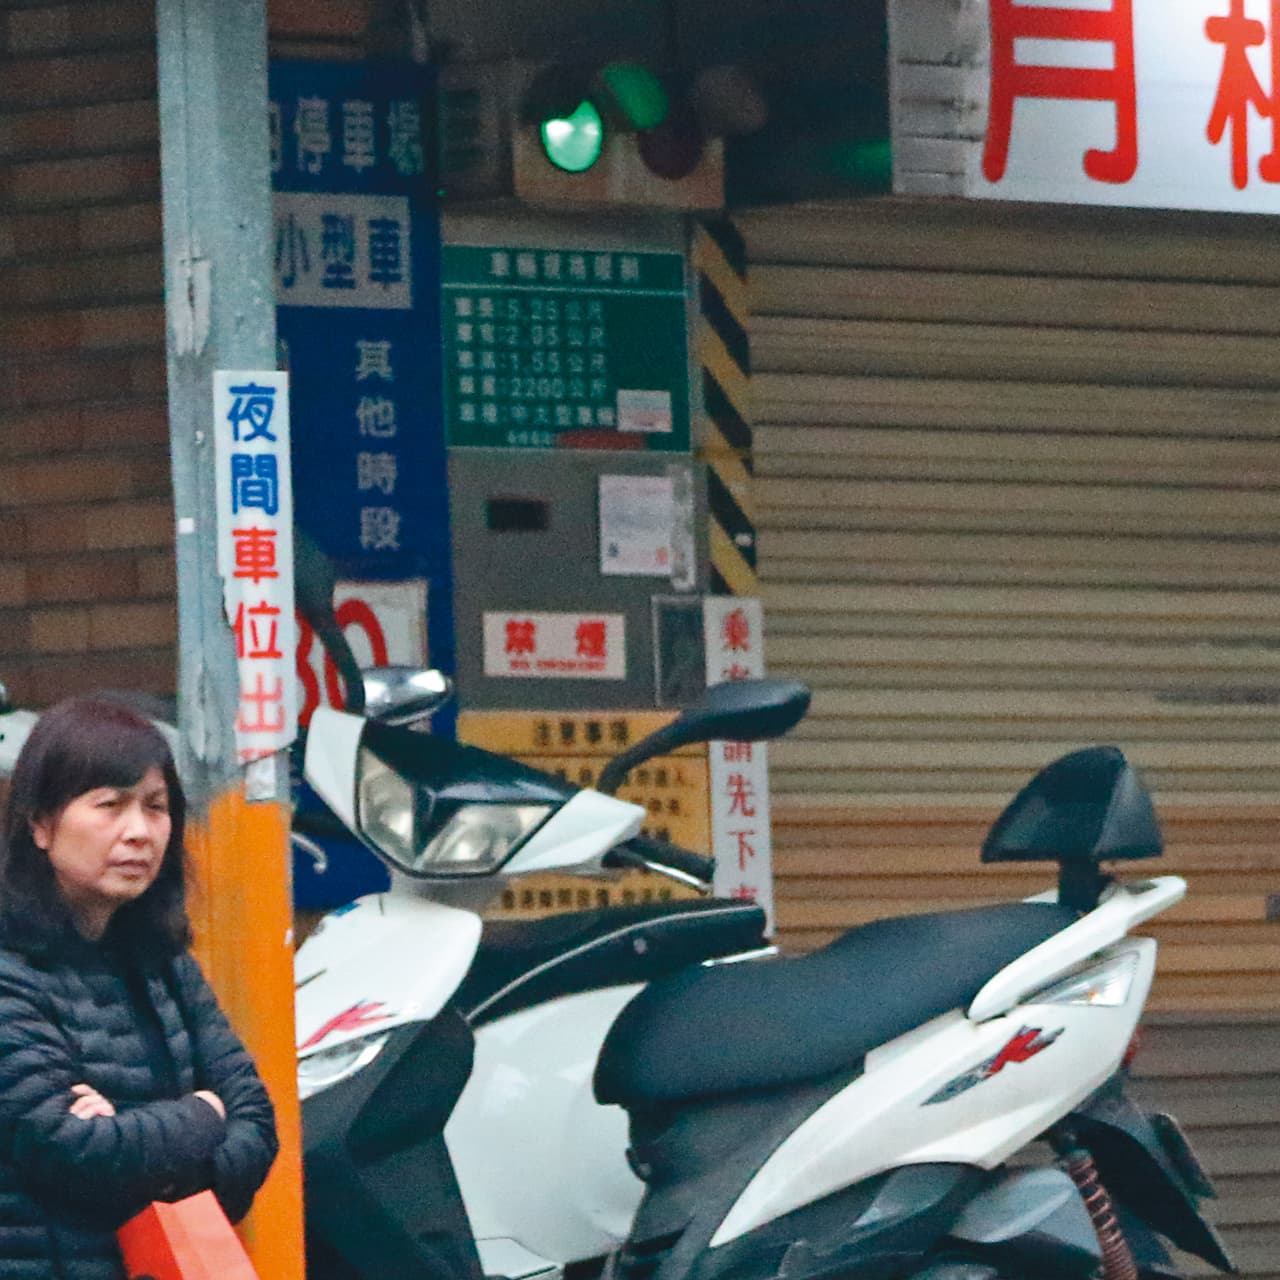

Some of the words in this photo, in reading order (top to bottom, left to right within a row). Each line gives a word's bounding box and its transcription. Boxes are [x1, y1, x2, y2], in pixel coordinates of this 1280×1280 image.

[273, 213, 403, 290] 小型車
[355, 340, 401, 551] 其他時段
[227, 382, 285, 760] 夜間車位出
